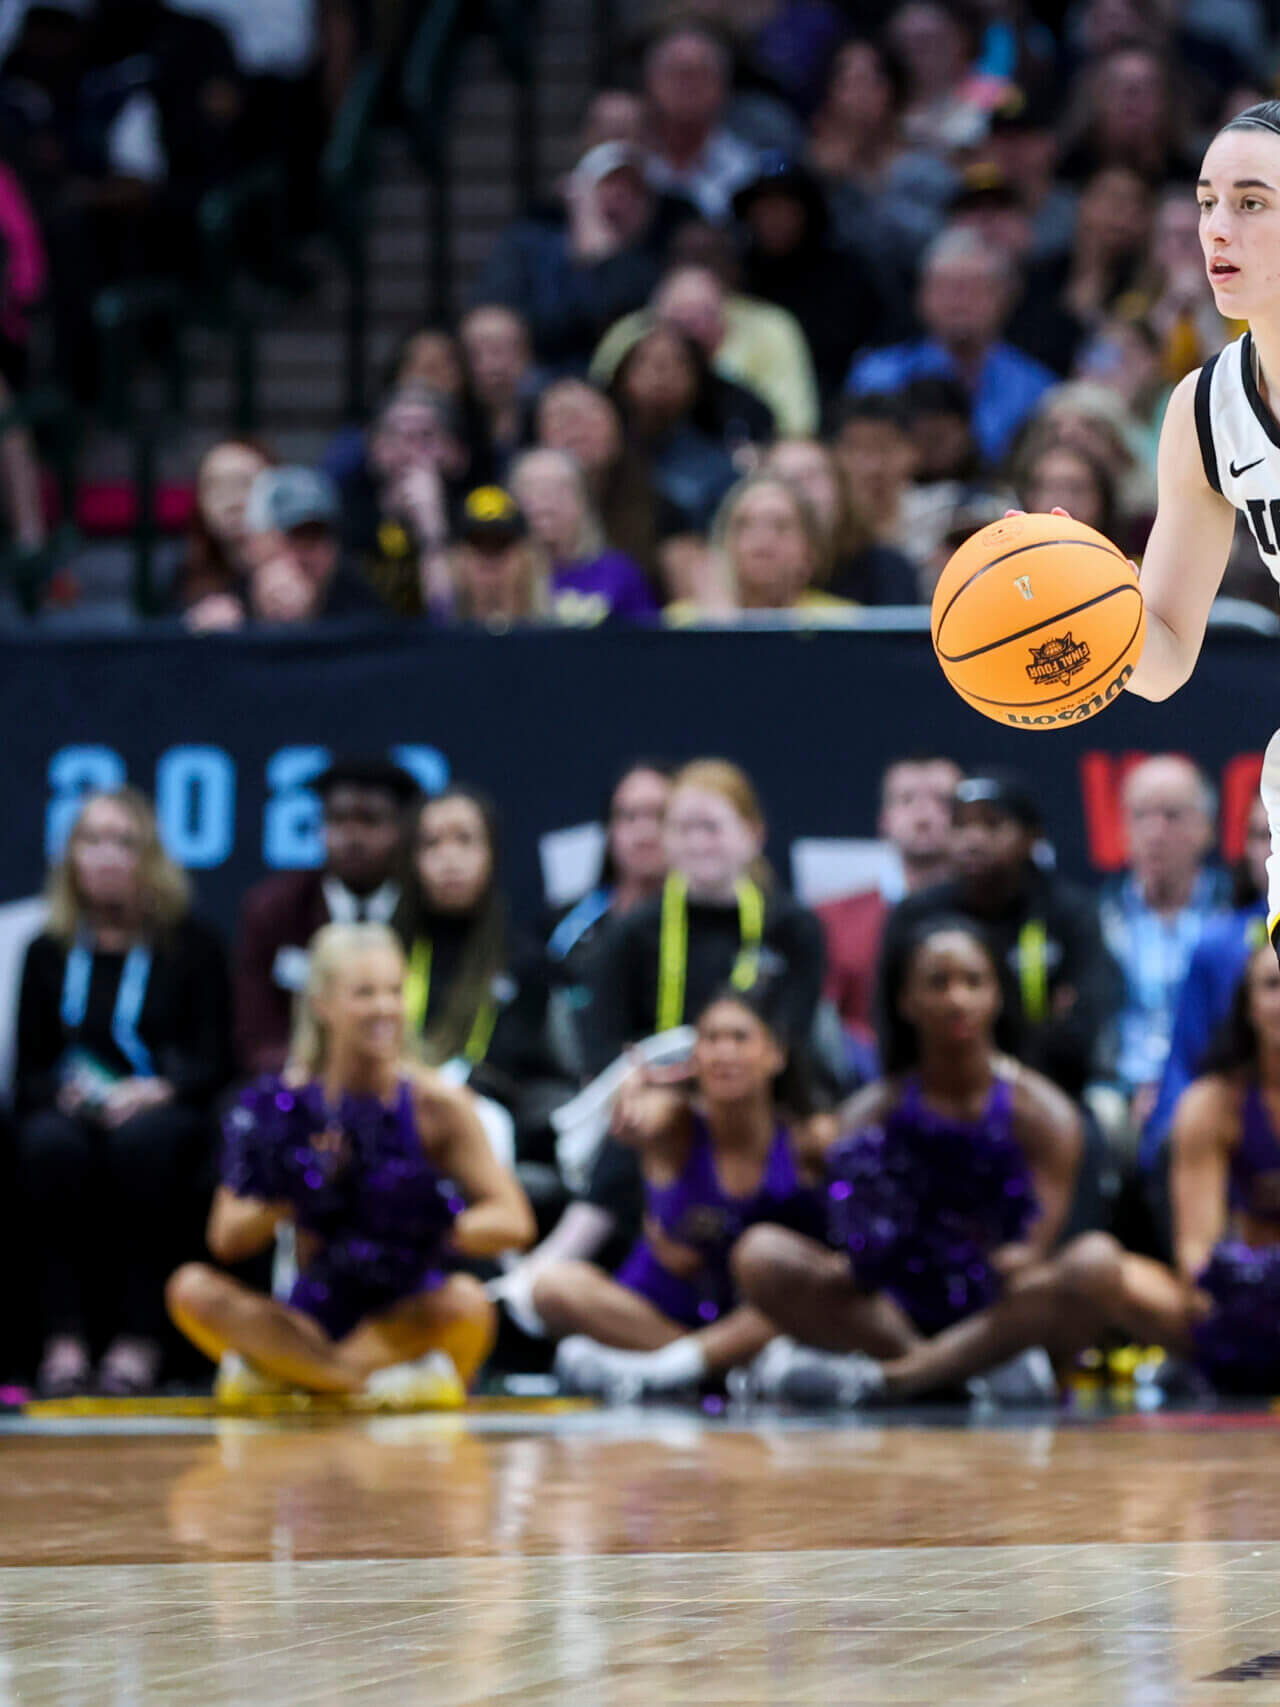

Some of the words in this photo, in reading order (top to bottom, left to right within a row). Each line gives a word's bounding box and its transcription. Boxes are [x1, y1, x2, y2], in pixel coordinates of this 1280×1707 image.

[1060, 643, 1088, 668] FINAL
[1028, 661, 1060, 679] FOUR
[46, 744, 450, 869] 202
